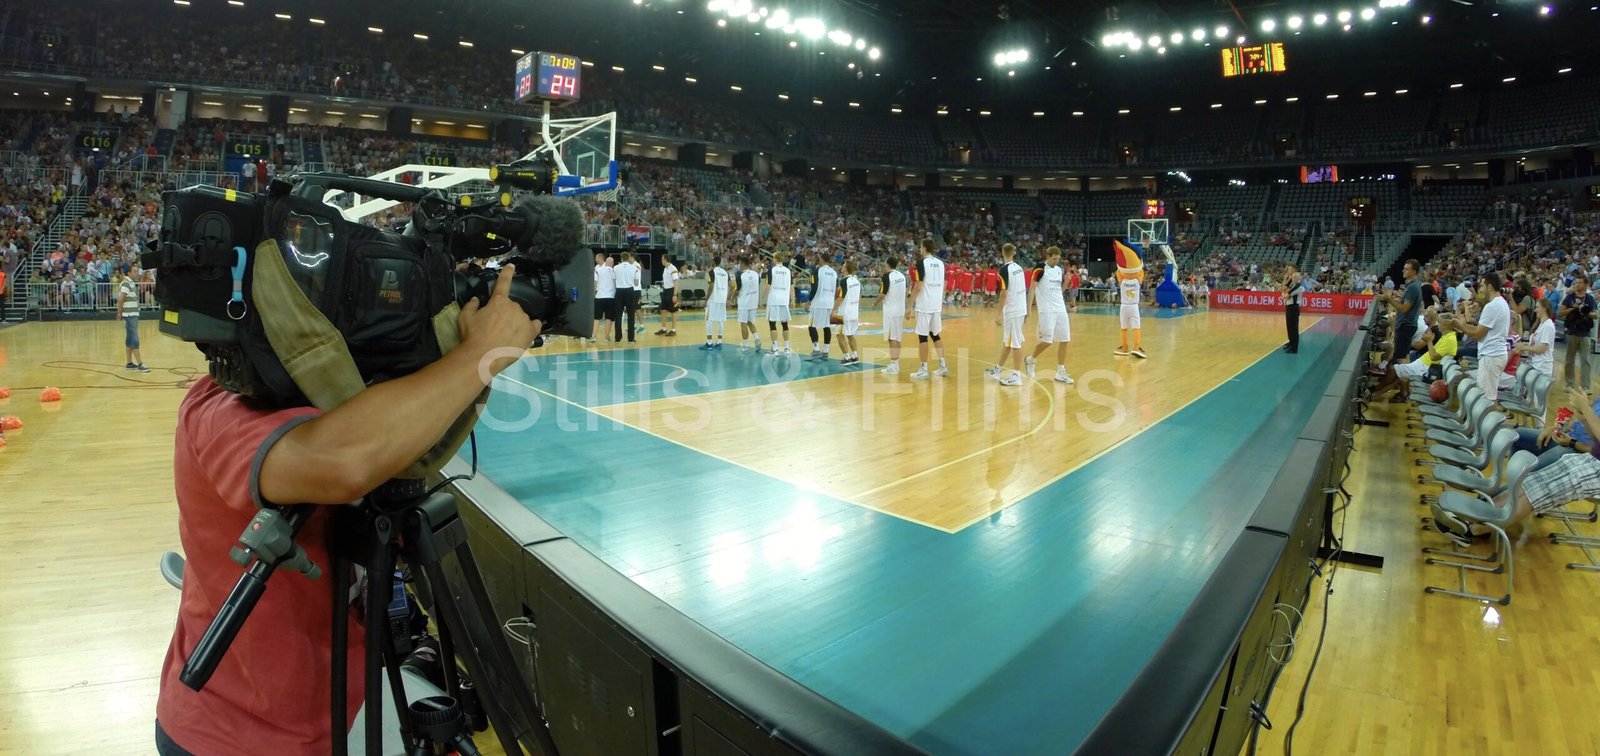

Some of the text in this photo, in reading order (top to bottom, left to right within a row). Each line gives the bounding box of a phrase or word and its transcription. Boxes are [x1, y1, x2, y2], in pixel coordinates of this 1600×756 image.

[551, 74, 575, 96] 24
[83, 136, 111, 148] C116
[234, 143, 261, 155] C115
[425, 155, 449, 167] C114
[1147, 206, 1158, 215] 24
[380, 290, 401, 298] PETROL
[1217, 294, 1244, 305] UVIJEK
[1248, 295, 1275, 306] DAJEM
[1311, 298, 1332, 308] SEBE
